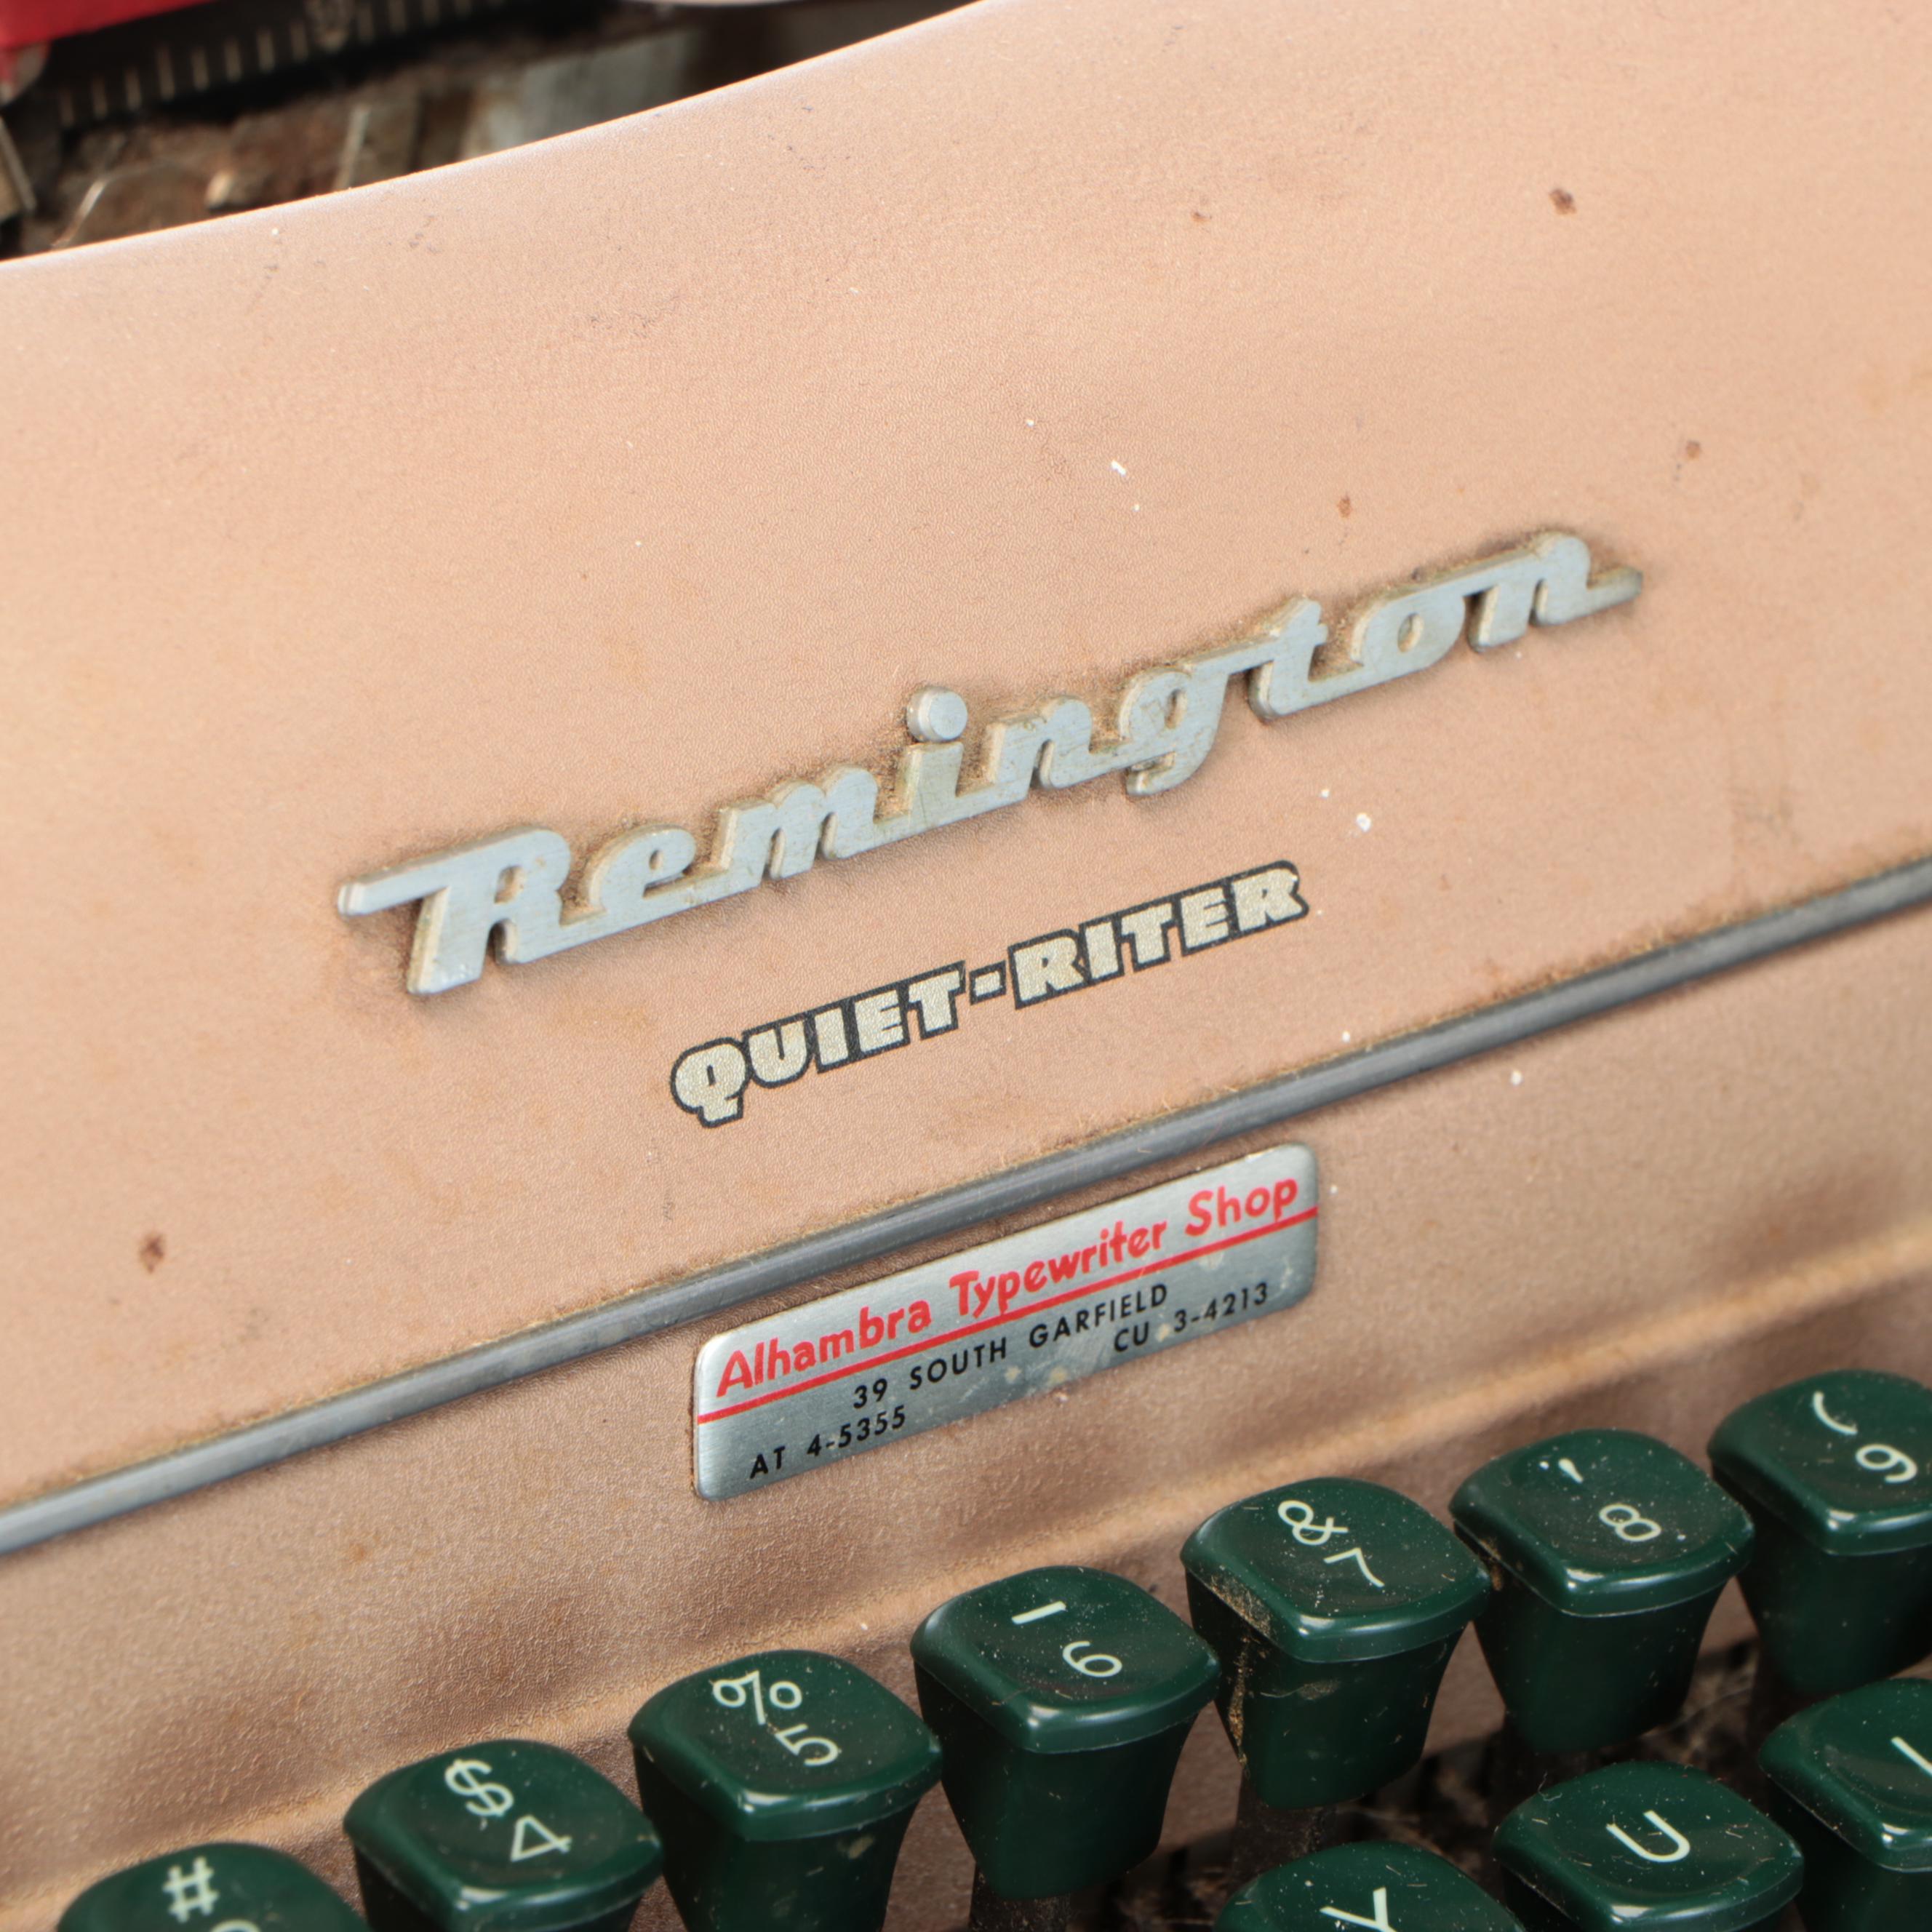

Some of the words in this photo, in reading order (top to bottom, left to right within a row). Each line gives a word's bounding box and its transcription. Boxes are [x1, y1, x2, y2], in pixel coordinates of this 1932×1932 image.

[337, 530, 1644, 996] Remington
[670, 859, 1309, 1128] QUIET-RITER
[716, 1298, 933, 1397] Alhambra
[949, 1220, 1169, 1319] Typewriter
[1184, 1177, 1298, 1237] Shop
[1113, 1321, 1150, 1353] CU
[1173, 1281, 1269, 1333] 3-4213
[853, 1378, 889, 1410] 39
[909, 1336, 1008, 1391] SOUTH
[1029, 1283, 1168, 1349] GARFIELD
[749, 1445, 786, 1480] AT
[805, 1404, 907, 1458] 4-5355
[1856, 1443, 1919, 1483] 9
[1277, 1499, 1349, 1546] &
[1599, 1503, 1662, 1542] 8
[1323, 1546, 1385, 1587] 7
[1062, 1640, 1123, 1677] 6
[712, 1669, 803, 1725] %
[774, 1723, 840, 1766] 5
[444, 1758, 514, 1817] $
[511, 1814, 572, 1862] 4
[1606, 1810, 1691, 1864] U
[163, 1856, 219, 1923] #
